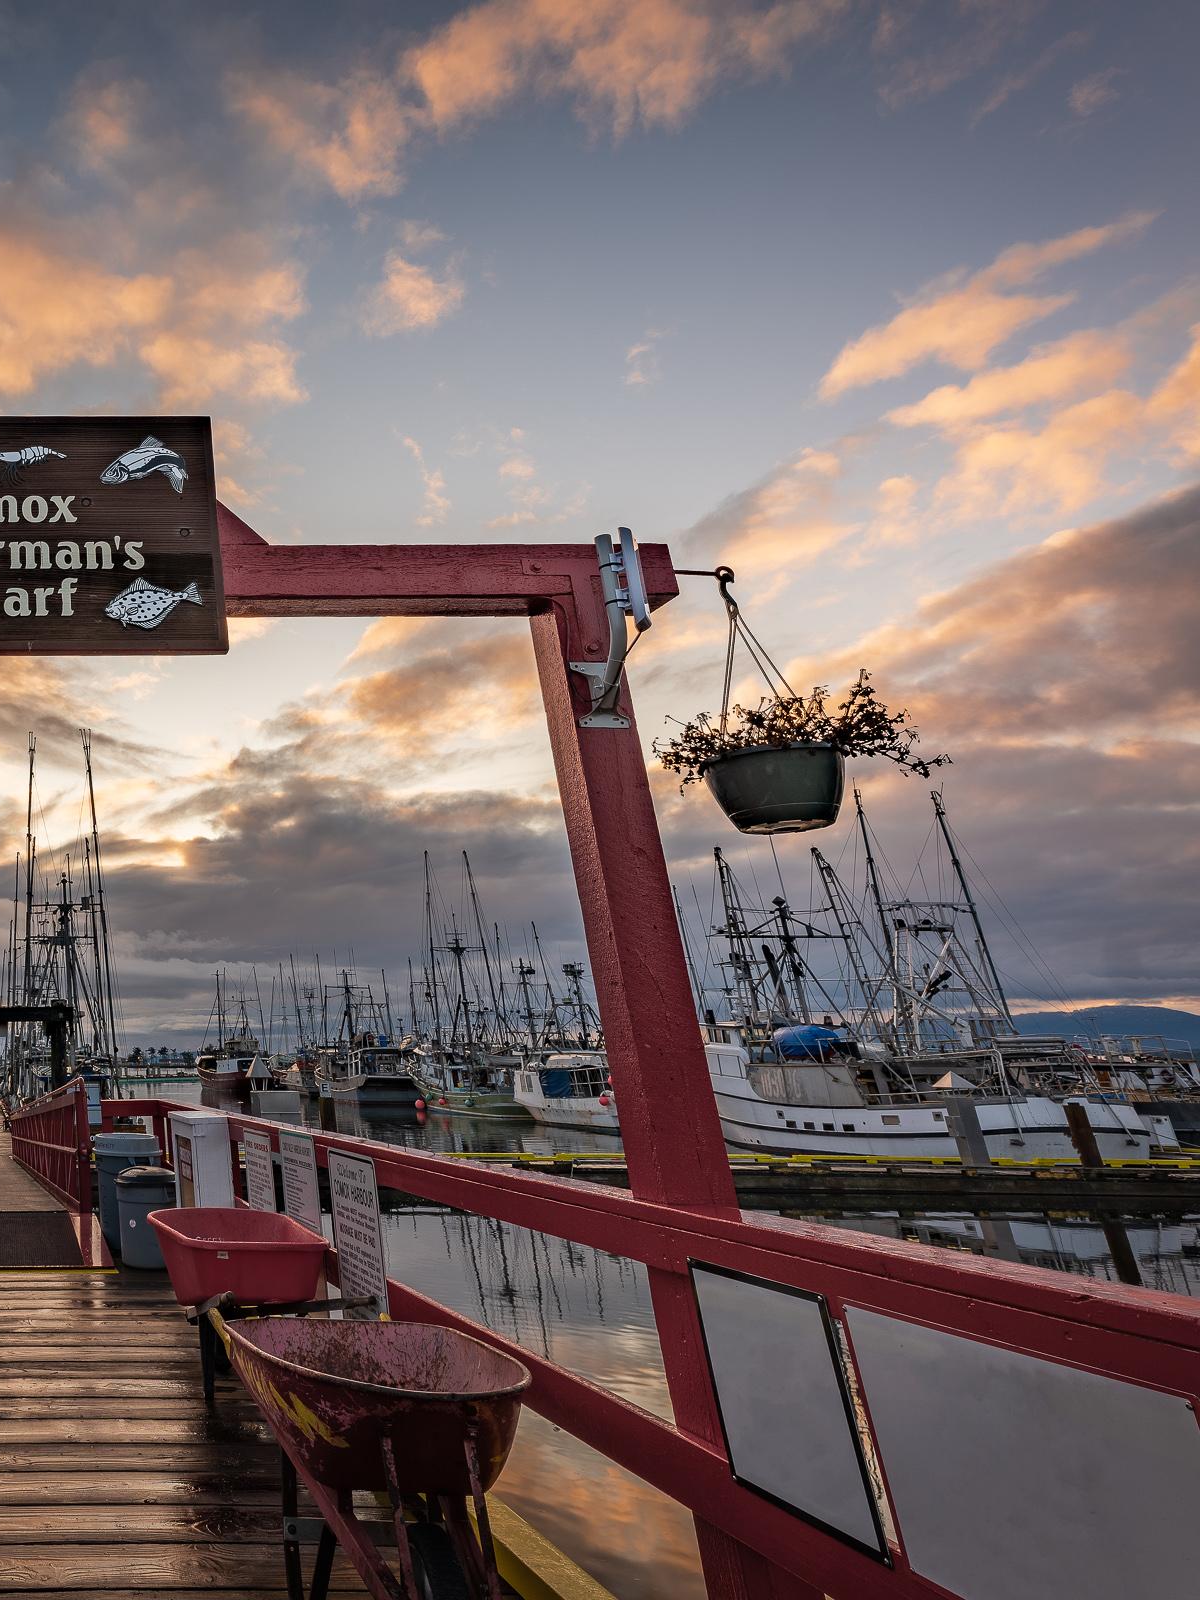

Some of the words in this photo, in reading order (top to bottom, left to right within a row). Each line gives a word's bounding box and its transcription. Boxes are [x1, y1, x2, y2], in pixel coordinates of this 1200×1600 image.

[321, 1083, 329, 1092] E
[334, 1179, 351, 1200] COMOX
[350, 1184, 375, 1209] HARBOUR
